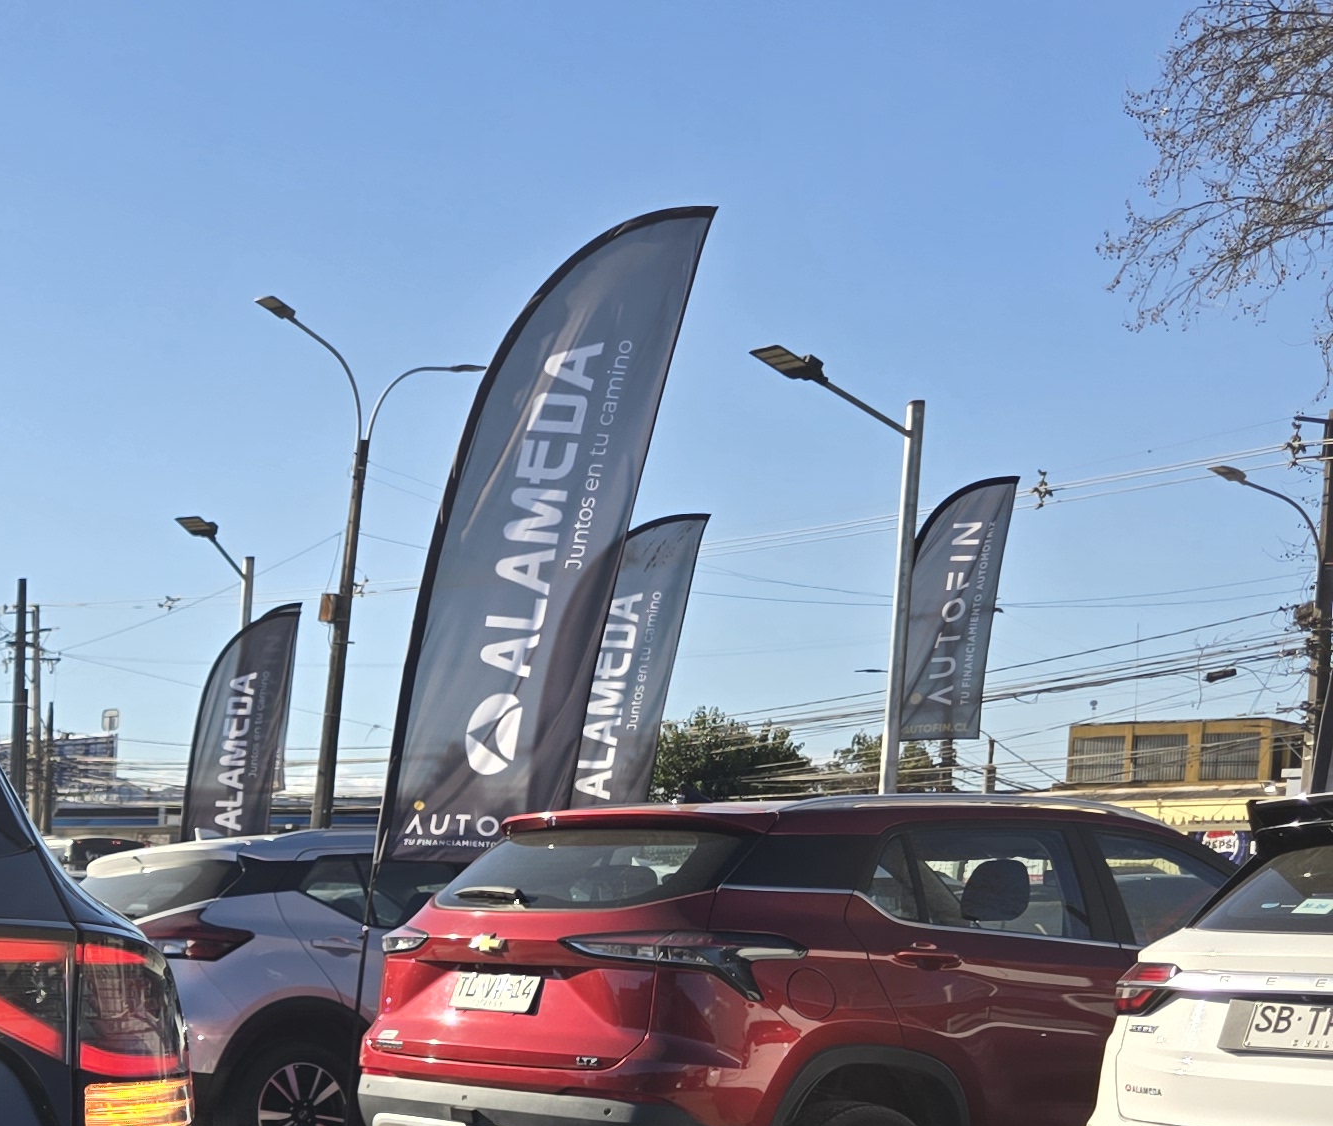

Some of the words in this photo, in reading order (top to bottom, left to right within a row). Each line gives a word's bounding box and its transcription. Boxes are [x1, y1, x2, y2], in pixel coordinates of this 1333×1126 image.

[600, 340, 633, 426] camino
[590, 432, 610, 456] tu
[585, 464, 603, 492] en
[480, 342, 604, 679] ALAMEDA
[564, 496, 596, 570] Juntos
[645, 591, 662, 644] camino
[926, 521, 983, 706] AUTOFIN
[641, 645, 652, 662] tu
[962, 593, 983, 692] FINANCIAMIENTO
[258, 671, 271, 709] camino
[636, 659, 649, 683] en
[575, 592, 644, 800] ALAMEDA
[626, 685, 645, 731] Juntos
[960, 693, 970, 706] TU
[253, 723, 263, 744] en
[255, 710, 264, 725] tu
[214, 671, 258, 832] ALAMEDA
[248, 745, 261, 778] Juntos
[404, 813, 500, 837] AUTO
